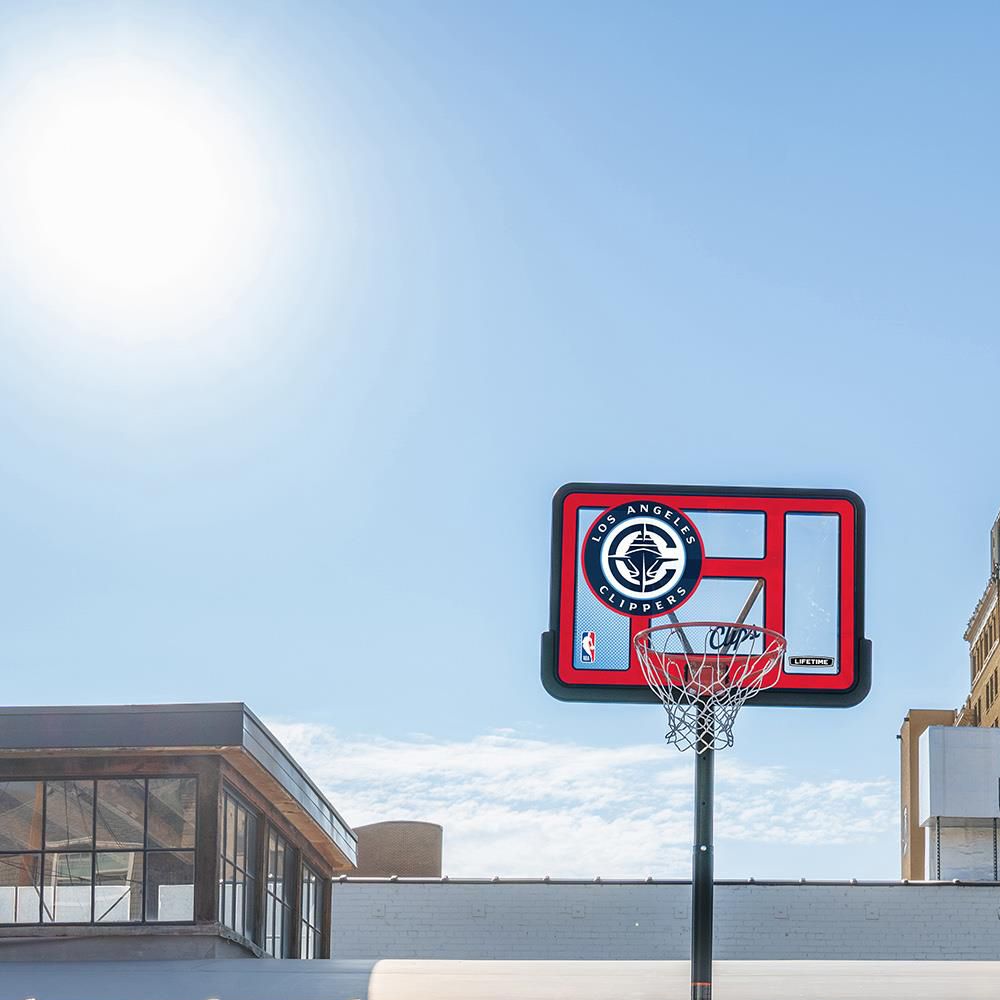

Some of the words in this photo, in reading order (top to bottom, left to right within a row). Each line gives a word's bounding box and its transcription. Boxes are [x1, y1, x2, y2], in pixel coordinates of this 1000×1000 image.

[592, 514, 616, 543] LOS
[627, 504, 696, 545] ANGELES
[599, 585, 686, 612] CLIPPERS
[794, 656, 829, 666] LIFETIME
